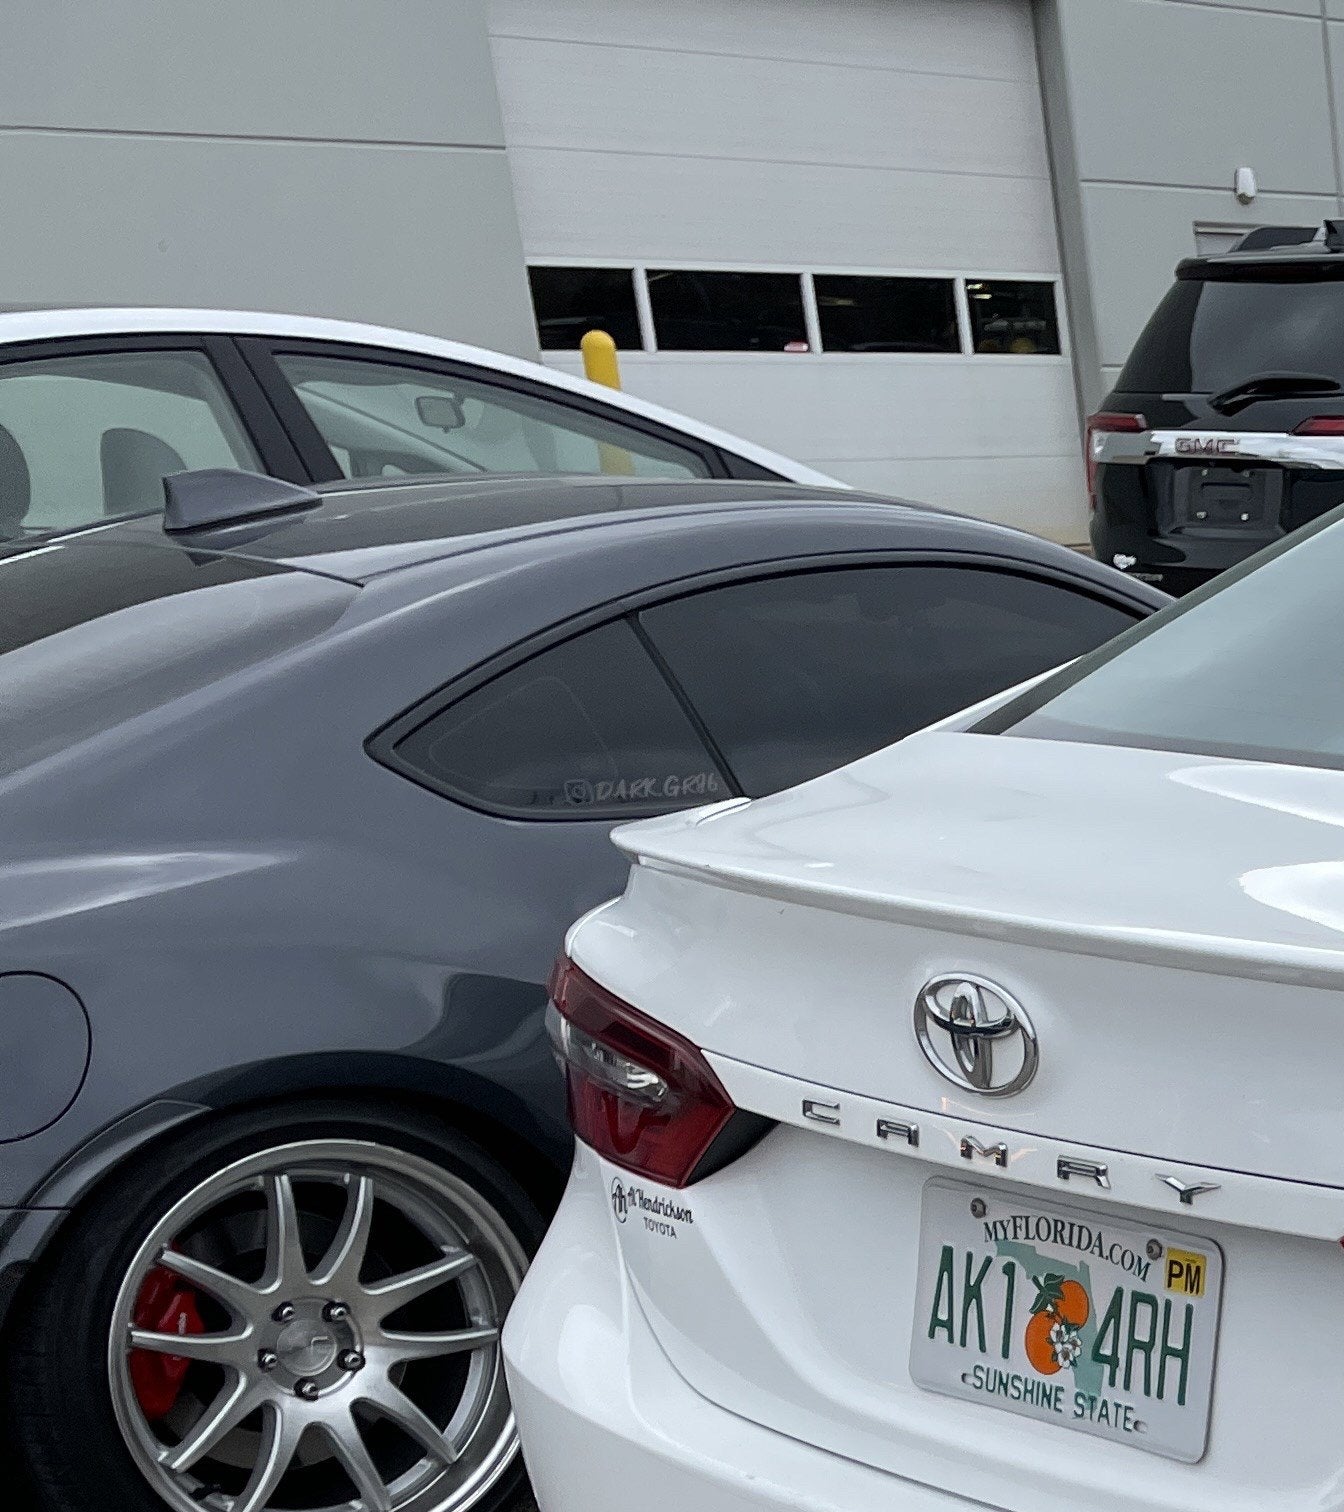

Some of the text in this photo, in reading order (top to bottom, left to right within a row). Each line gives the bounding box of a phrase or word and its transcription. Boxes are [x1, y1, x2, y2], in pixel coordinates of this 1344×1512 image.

[1174, 437, 1240, 454] GMC
[802, 1098, 1222, 1205] CAMRY
[643, 1216, 678, 1240] TOYOTA
[983, 1215, 1151, 1283] MYFLORIDA.COM
[1166, 1259, 1202, 1296] PM
[1091, 1286, 1194, 1406] 4RH
[972, 1365, 1135, 1433] SUNSHINE STATE
